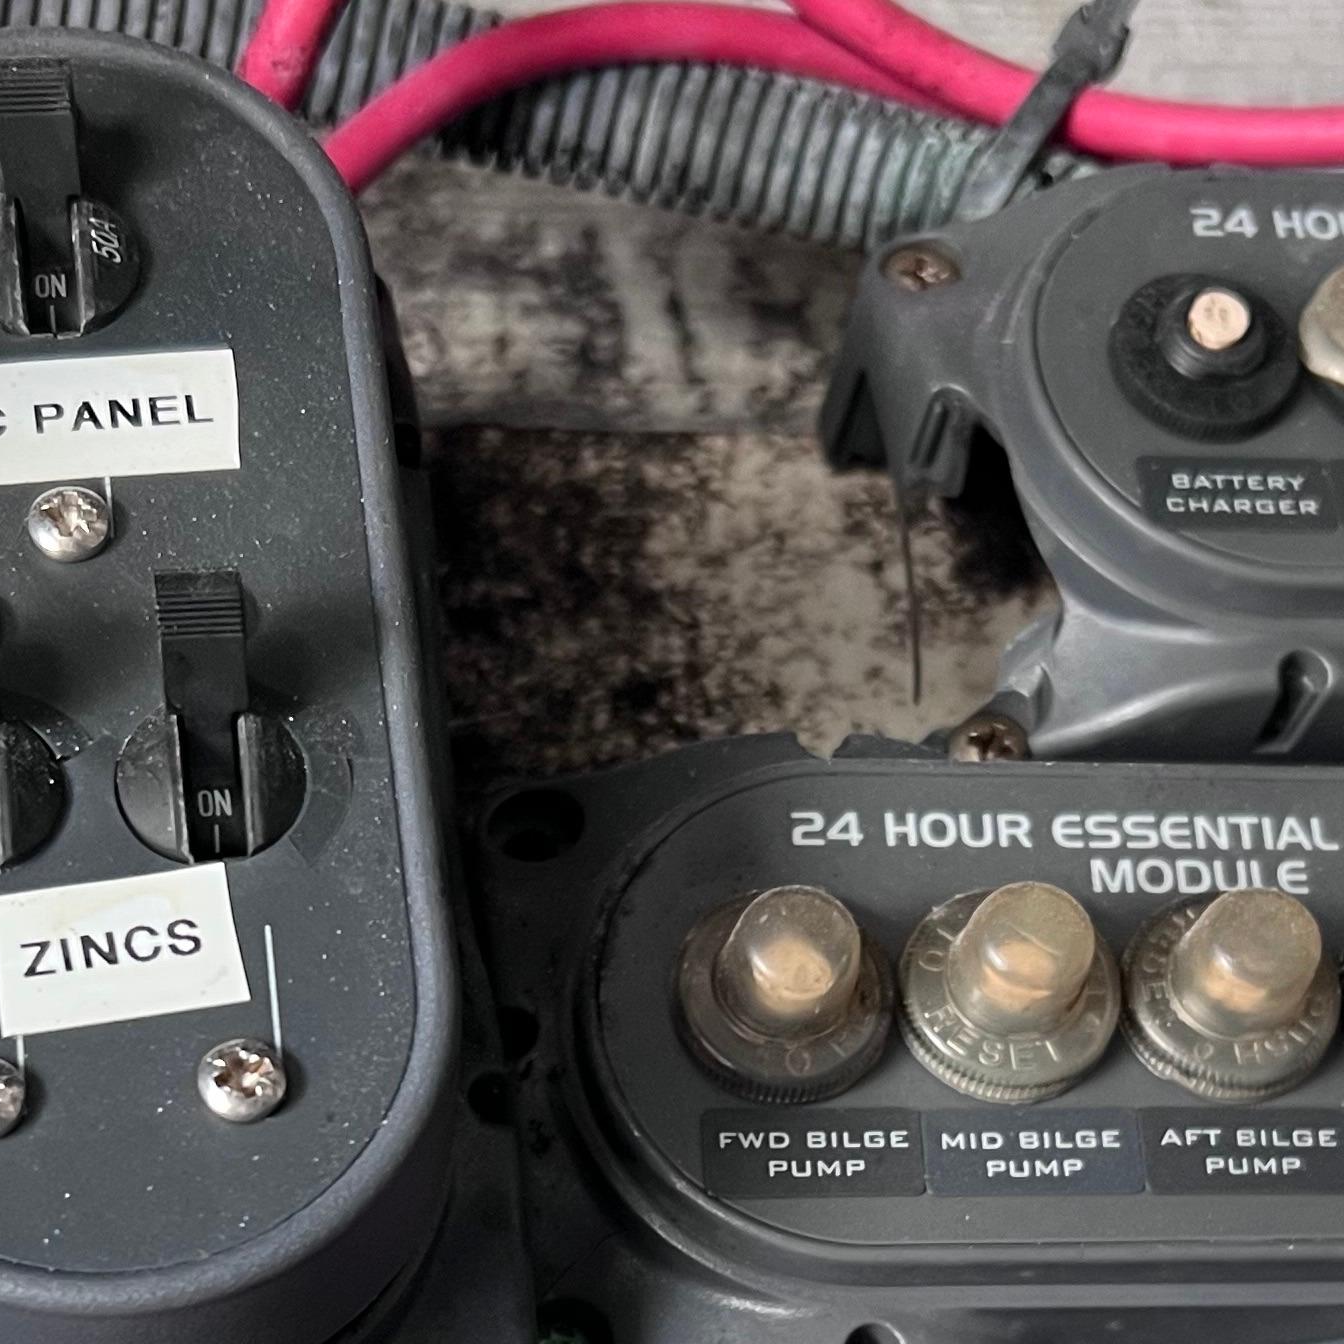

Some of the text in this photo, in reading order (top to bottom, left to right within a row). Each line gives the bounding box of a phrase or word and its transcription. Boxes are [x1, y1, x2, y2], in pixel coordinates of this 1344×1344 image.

[1190, 207, 1258, 238] 24
[89, 217, 121, 263] 50A
[35, 273, 67, 299] ON
[34, 393, 214, 434] PANEL
[1170, 473, 1306, 491] BATTERY
[1165, 496, 1320, 515] CHARGER
[198, 789, 233, 818] ON
[790, 811, 864, 848] 24
[884, 812, 1034, 848] HOUR
[1051, 813, 1340, 852] ESSENTIAL
[1090, 859, 1310, 895] MODULE
[21, 918, 203, 978] ZINCS
[719, 1130, 910, 1151] FWD BILGE
[941, 1129, 1121, 1151] MID BILGE
[1160, 1127, 1338, 1148] AFT BILGE
[768, 1158, 866, 1179] PUMP
[986, 1157, 1083, 1179] PUMP
[1205, 1155, 1302, 1176] PUMP
